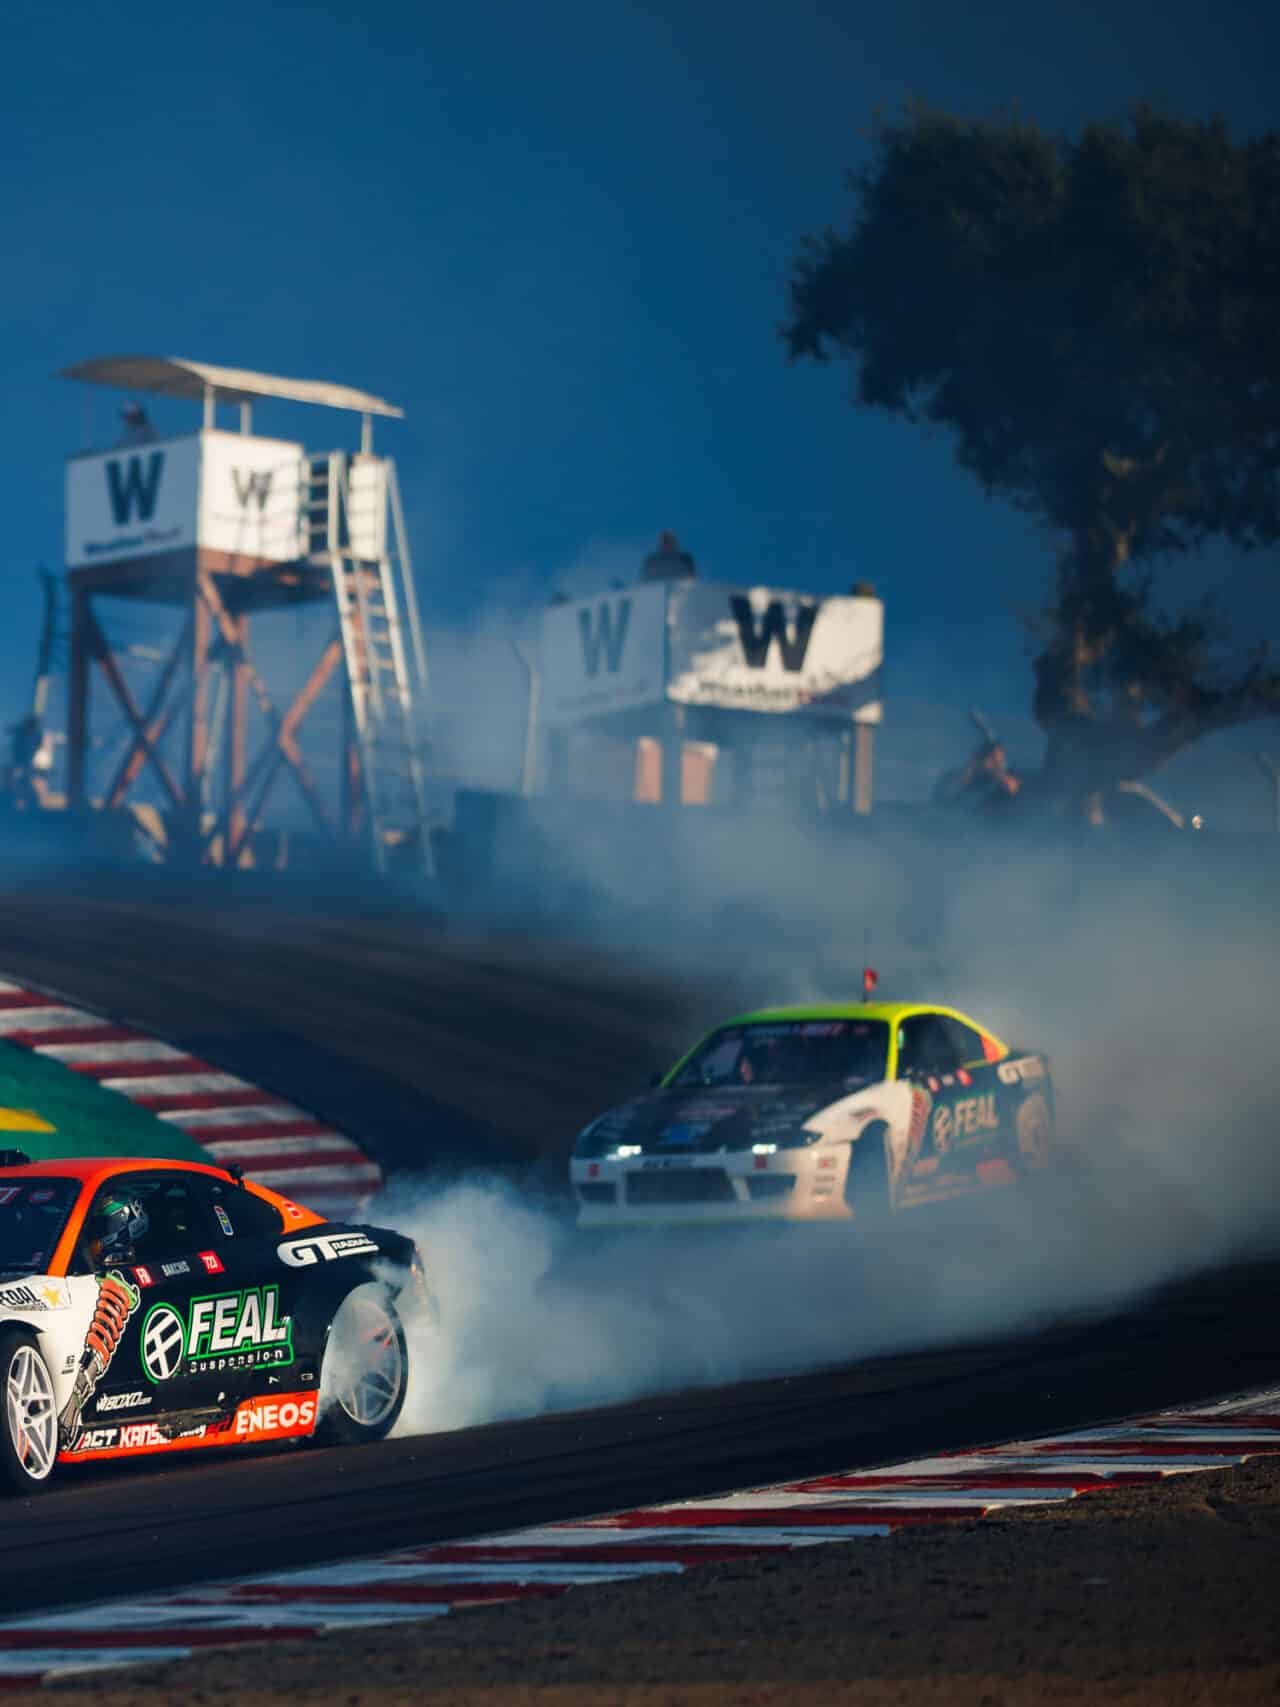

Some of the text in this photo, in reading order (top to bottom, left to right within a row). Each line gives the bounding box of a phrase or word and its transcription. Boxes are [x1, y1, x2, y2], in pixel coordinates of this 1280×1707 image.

[107, 450, 165, 526] W
[231, 465, 274, 512] W
[577, 597, 632, 680] W
[728, 594, 819, 673] W
[953, 1093, 1000, 1137] FEAL
[187, 1291, 288, 1355] FEAL
[235, 1401, 315, 1436] ENEOS
